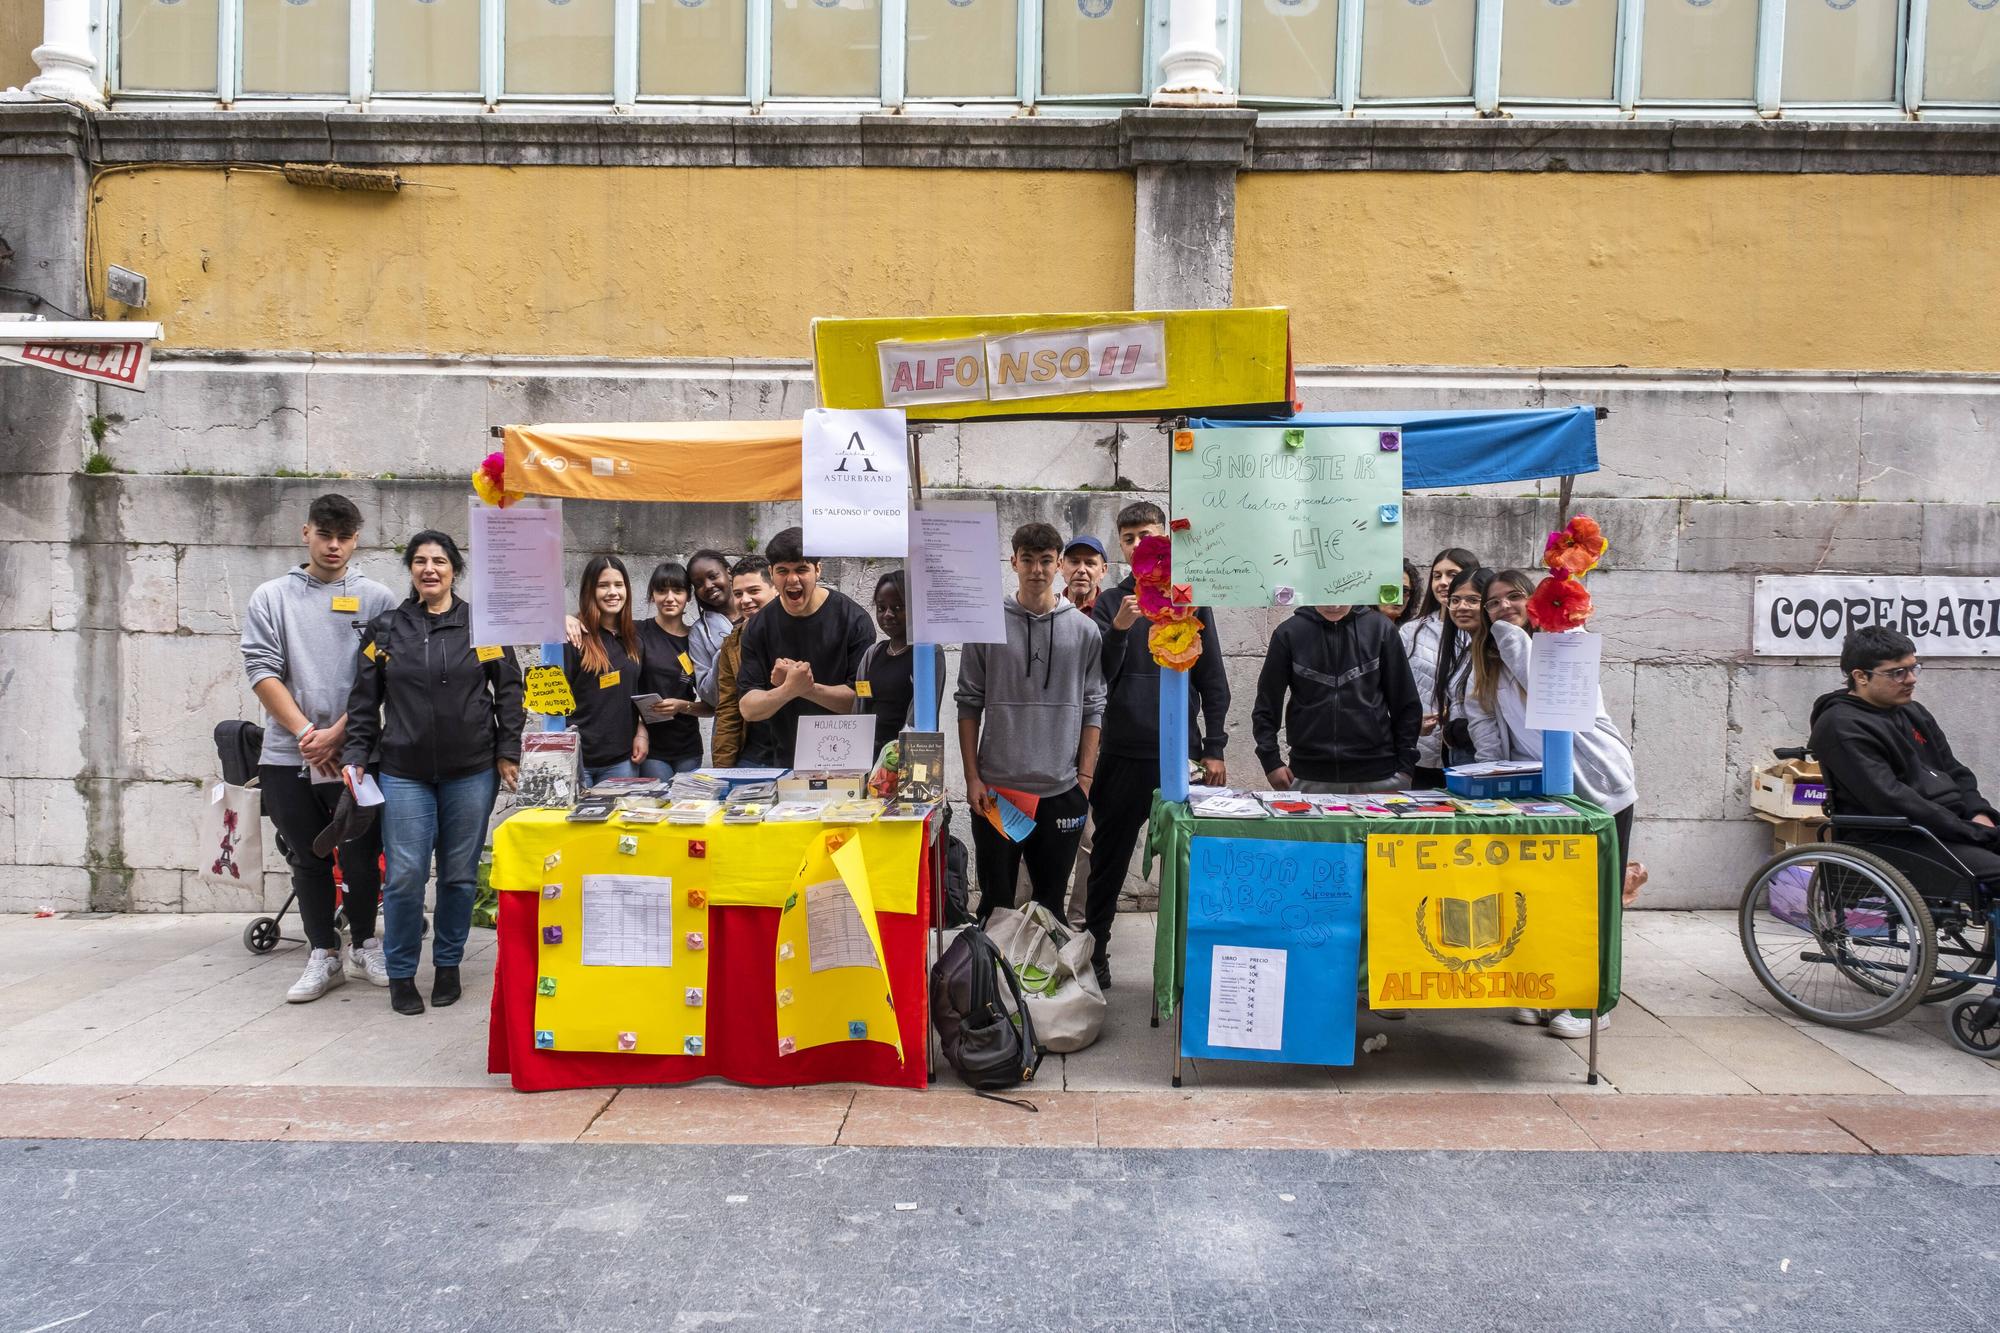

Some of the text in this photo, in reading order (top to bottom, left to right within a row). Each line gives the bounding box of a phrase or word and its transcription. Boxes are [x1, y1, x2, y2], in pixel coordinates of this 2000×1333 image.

[891, 346, 1090, 392] ALFONSO
[824, 474, 892, 482] ASTURBRAND
[1229, 454, 1256, 479] NO
[1354, 453, 1376, 480] IR
[812, 508, 823, 516] IES
[814, 720, 857, 729] HOJALDRES
[1519, 839, 1580, 861] EJE
[1312, 858, 1346, 884] DE
[1379, 971, 1556, 1001] ALFONSINOS
